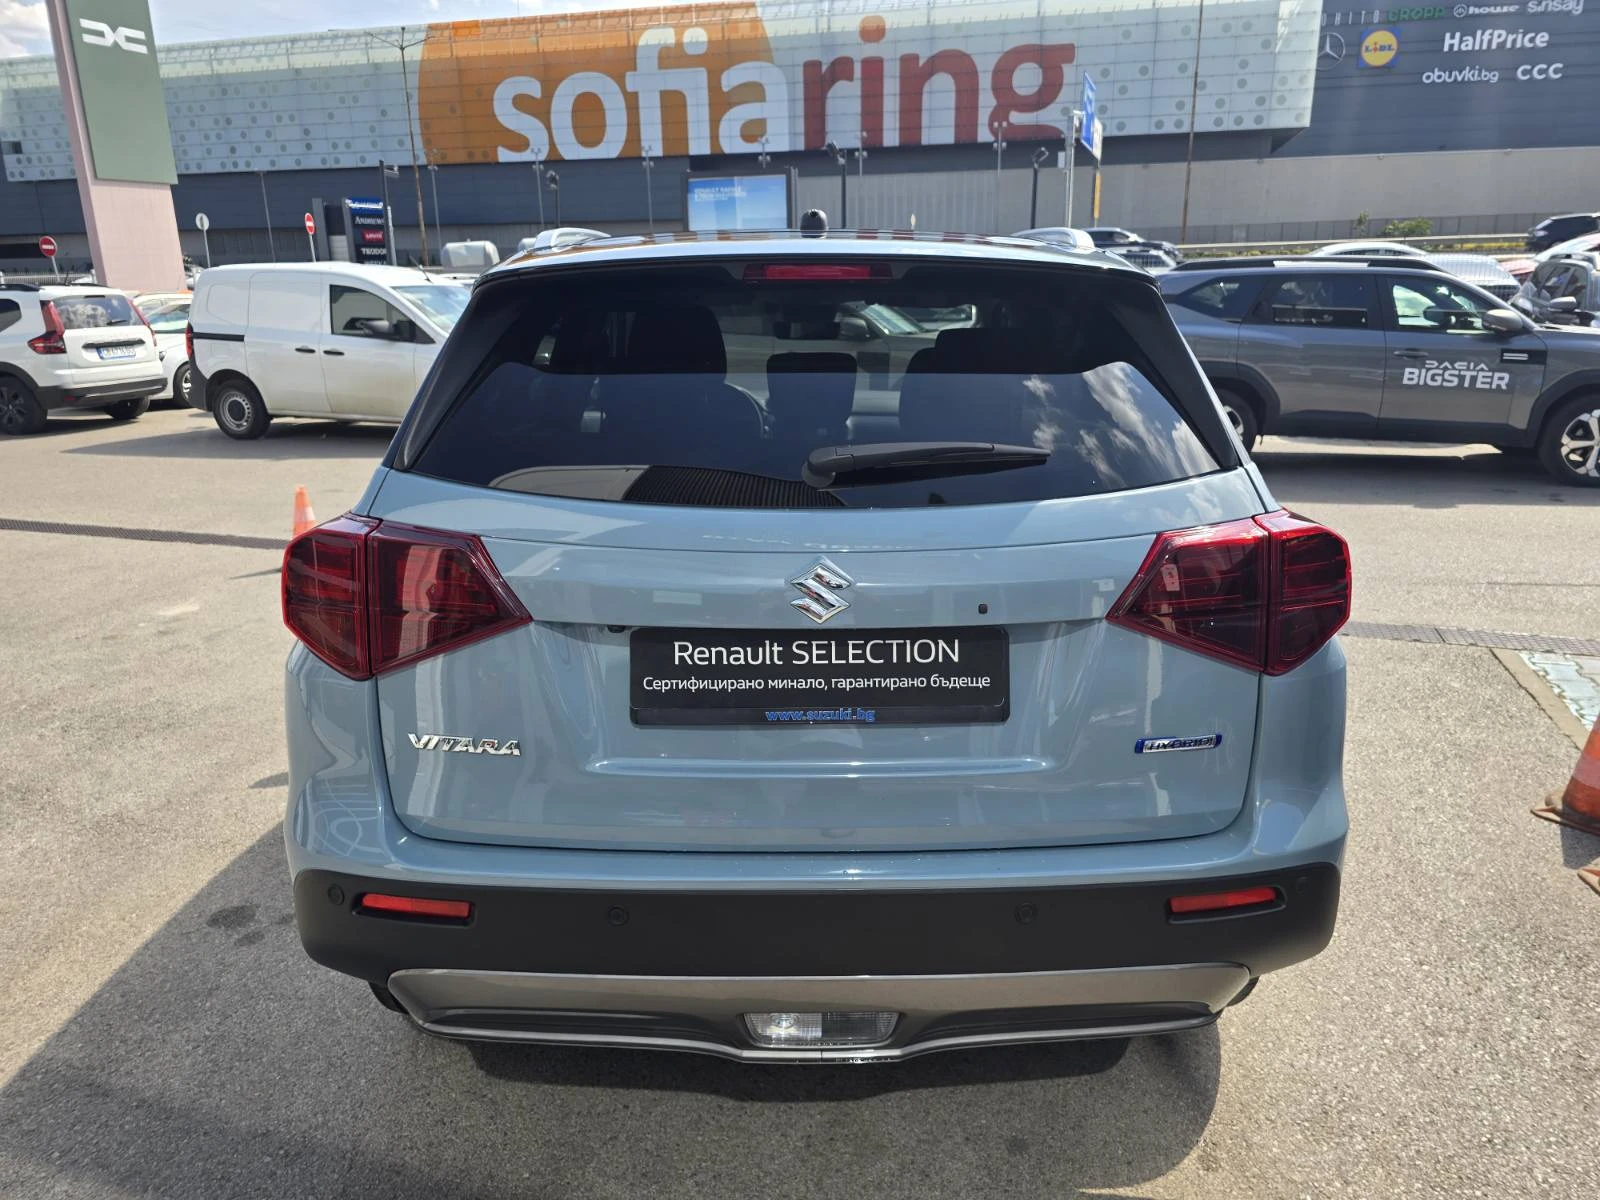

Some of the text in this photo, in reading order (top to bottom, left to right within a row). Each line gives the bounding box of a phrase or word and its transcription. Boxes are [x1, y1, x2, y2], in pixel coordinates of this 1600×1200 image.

[1320, 9, 1380, 26] OHITO
[1443, 28, 1550, 52] HalfPrice
[1422, 65, 1500, 84] obuvki.bg
[1516, 62, 1564, 81] CCC
[1425, 360, 1489, 370] DACIA
[1402, 367, 1510, 390] BIGSTER
[673, 638, 960, 666] Renault SELECTION
[643, 673, 991, 693] Сертифицирано минало, гарантирано бъдеще
[765, 708, 877, 723] www.suzuki.bg
[407, 733, 521, 756] VITARA
